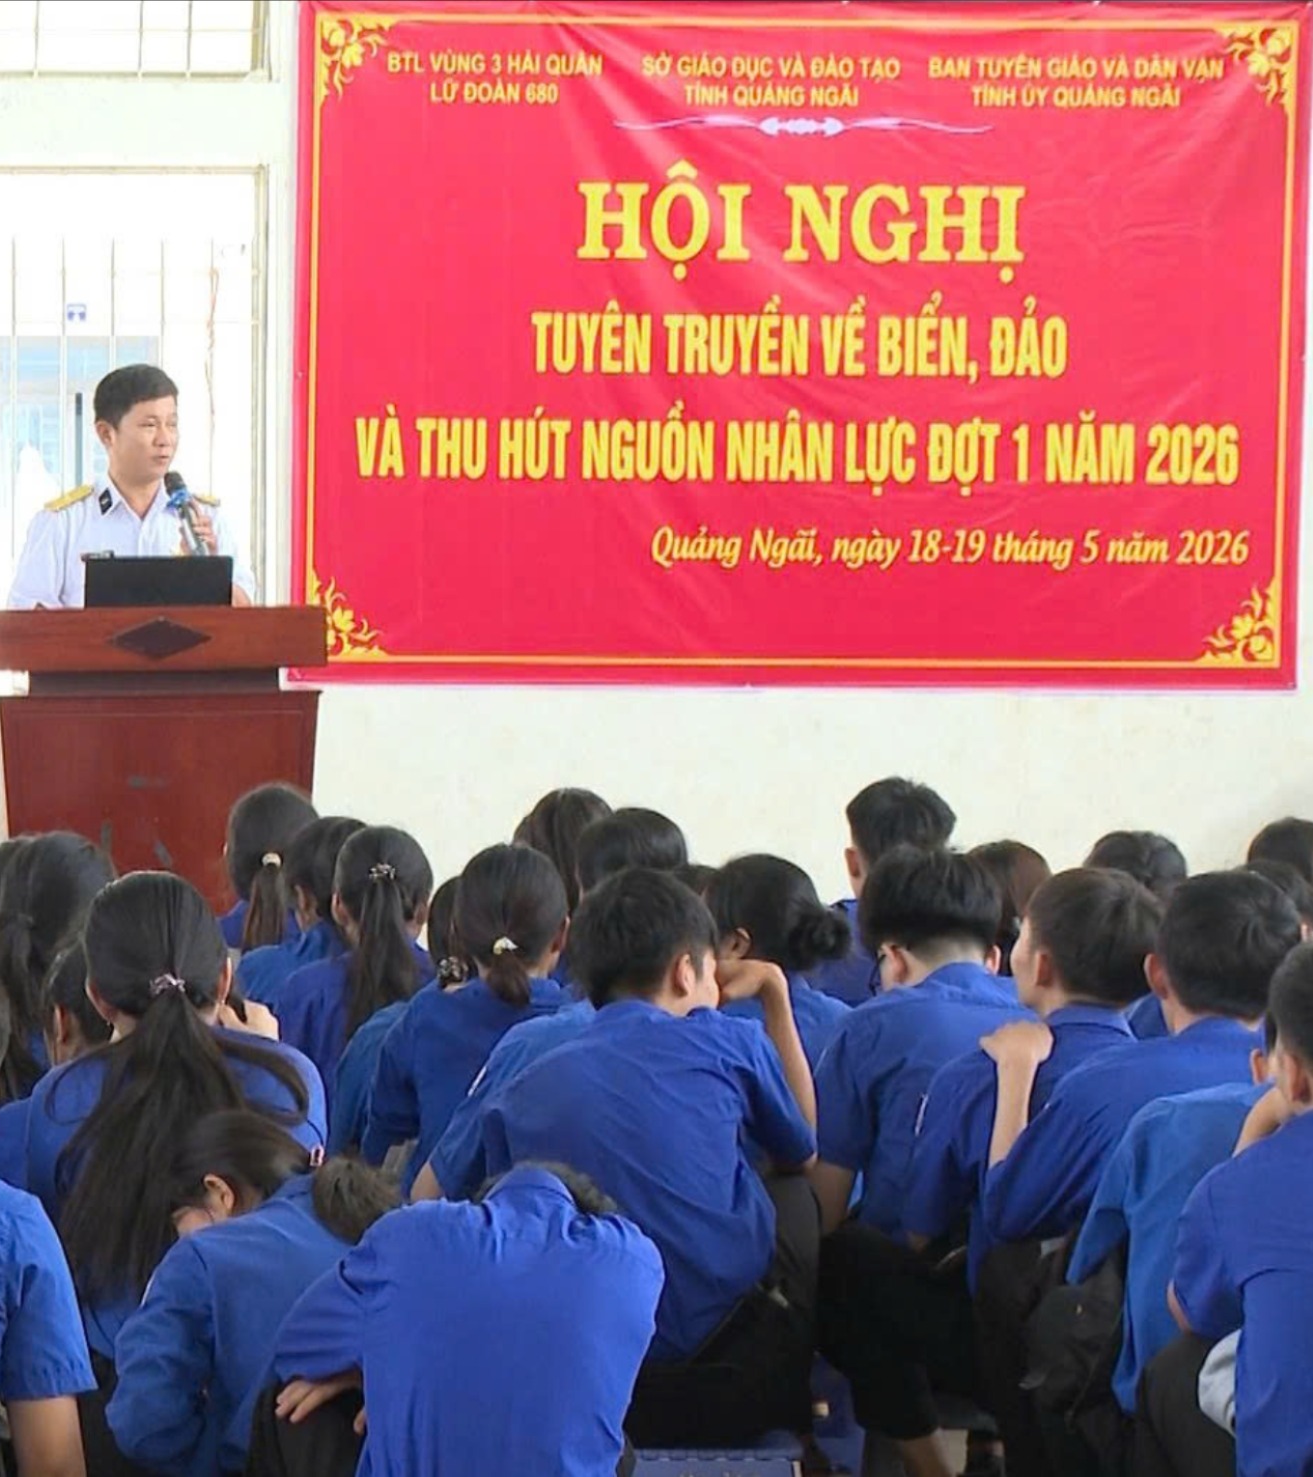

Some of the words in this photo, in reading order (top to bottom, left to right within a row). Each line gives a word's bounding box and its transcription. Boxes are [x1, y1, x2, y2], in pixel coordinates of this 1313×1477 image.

[387, 53, 424, 73] BTL
[429, 49, 486, 74] VÙNG
[491, 53, 502, 74] 3
[545, 50, 604, 76] QUÂN
[642, 50, 673, 77] SỞ
[676, 51, 728, 78] GIÁO
[779, 51, 806, 78] VÀ
[810, 51, 855, 78] ĐÀO
[859, 57, 901, 83] TẠO
[928, 56, 971, 79] BAN
[976, 53, 1041, 79] TUYÊN
[1047, 53, 1098, 79] GIÁO
[1102, 53, 1130, 79] VÀ
[1134, 53, 1177, 79] DÂN
[463, 76, 520, 103] ĐOÀN
[525, 82, 559, 104] 680
[684, 80, 728, 106] TỈNH
[733, 82, 805, 107] QUẢNG
[810, 82, 859, 107] NGÃI
[972, 82, 1016, 107] TỈNH
[1053, 83, 1126, 108] QUẢNG
[1130, 83, 1181, 108] NGÃI
[577, 159, 751, 281] HỘI
[783, 183, 1026, 284] NGHỊ
[531, 298, 652, 374] TUYÊN
[663, 294, 809, 376] TRUYỀN
[820, 295, 866, 376] VỀ
[878, 290, 979, 384] BIỂN,
[989, 295, 1068, 378] ĐẢO
[355, 403, 405, 478] VÀ
[416, 417, 488, 479] THU
[499, 406, 572, 480] HÚT
[582, 399, 715, 481] NGUỒN
[726, 408, 834, 482] NHÂN
[845, 416, 916, 496] LỰC
[928, 417, 1001, 496] ĐỢT
[1012, 424, 1030, 483] 1
[1046, 409, 1135, 484] NĂM
[1145, 425, 1240, 485] 2026
[651, 525, 742, 568] Quảng
[749, 527, 823, 568] Ngãi,
[831, 528, 901, 570] ngày
[907, 529, 986, 563] 18-19
[992, 530, 1074, 571] tháng
[1080, 529, 1101, 563] 5
[1106, 531, 1170, 563] năm
[1175, 529, 1251, 565] 2026
